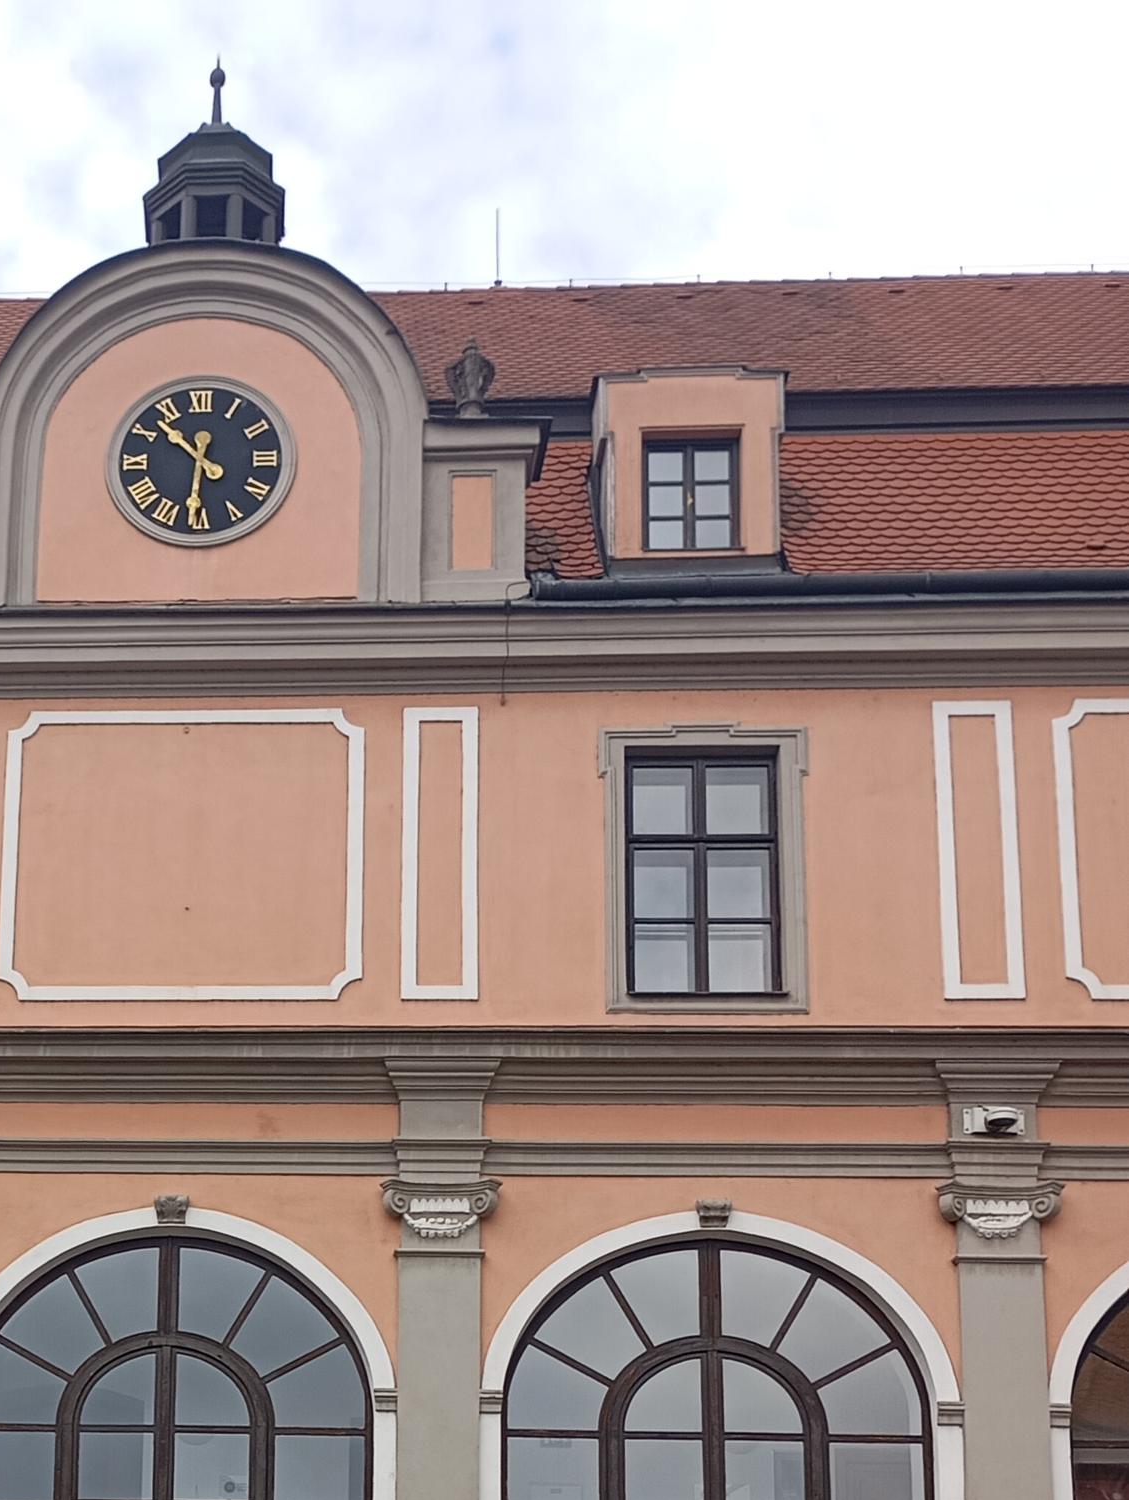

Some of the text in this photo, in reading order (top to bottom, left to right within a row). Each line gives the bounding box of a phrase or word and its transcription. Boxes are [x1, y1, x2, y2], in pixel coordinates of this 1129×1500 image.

[155, 397, 181, 423] XI
[188, 391, 213, 412] XII
[225, 398, 242, 419] I
[132, 423, 158, 442] X
[244, 419, 269, 439] II
[123, 453, 148, 471] IX
[253, 450, 277, 467] III
[127, 476, 159, 510] VIII
[244, 477, 270, 501] IV
[152, 498, 180, 526] VII
[225, 501, 243, 521] V
